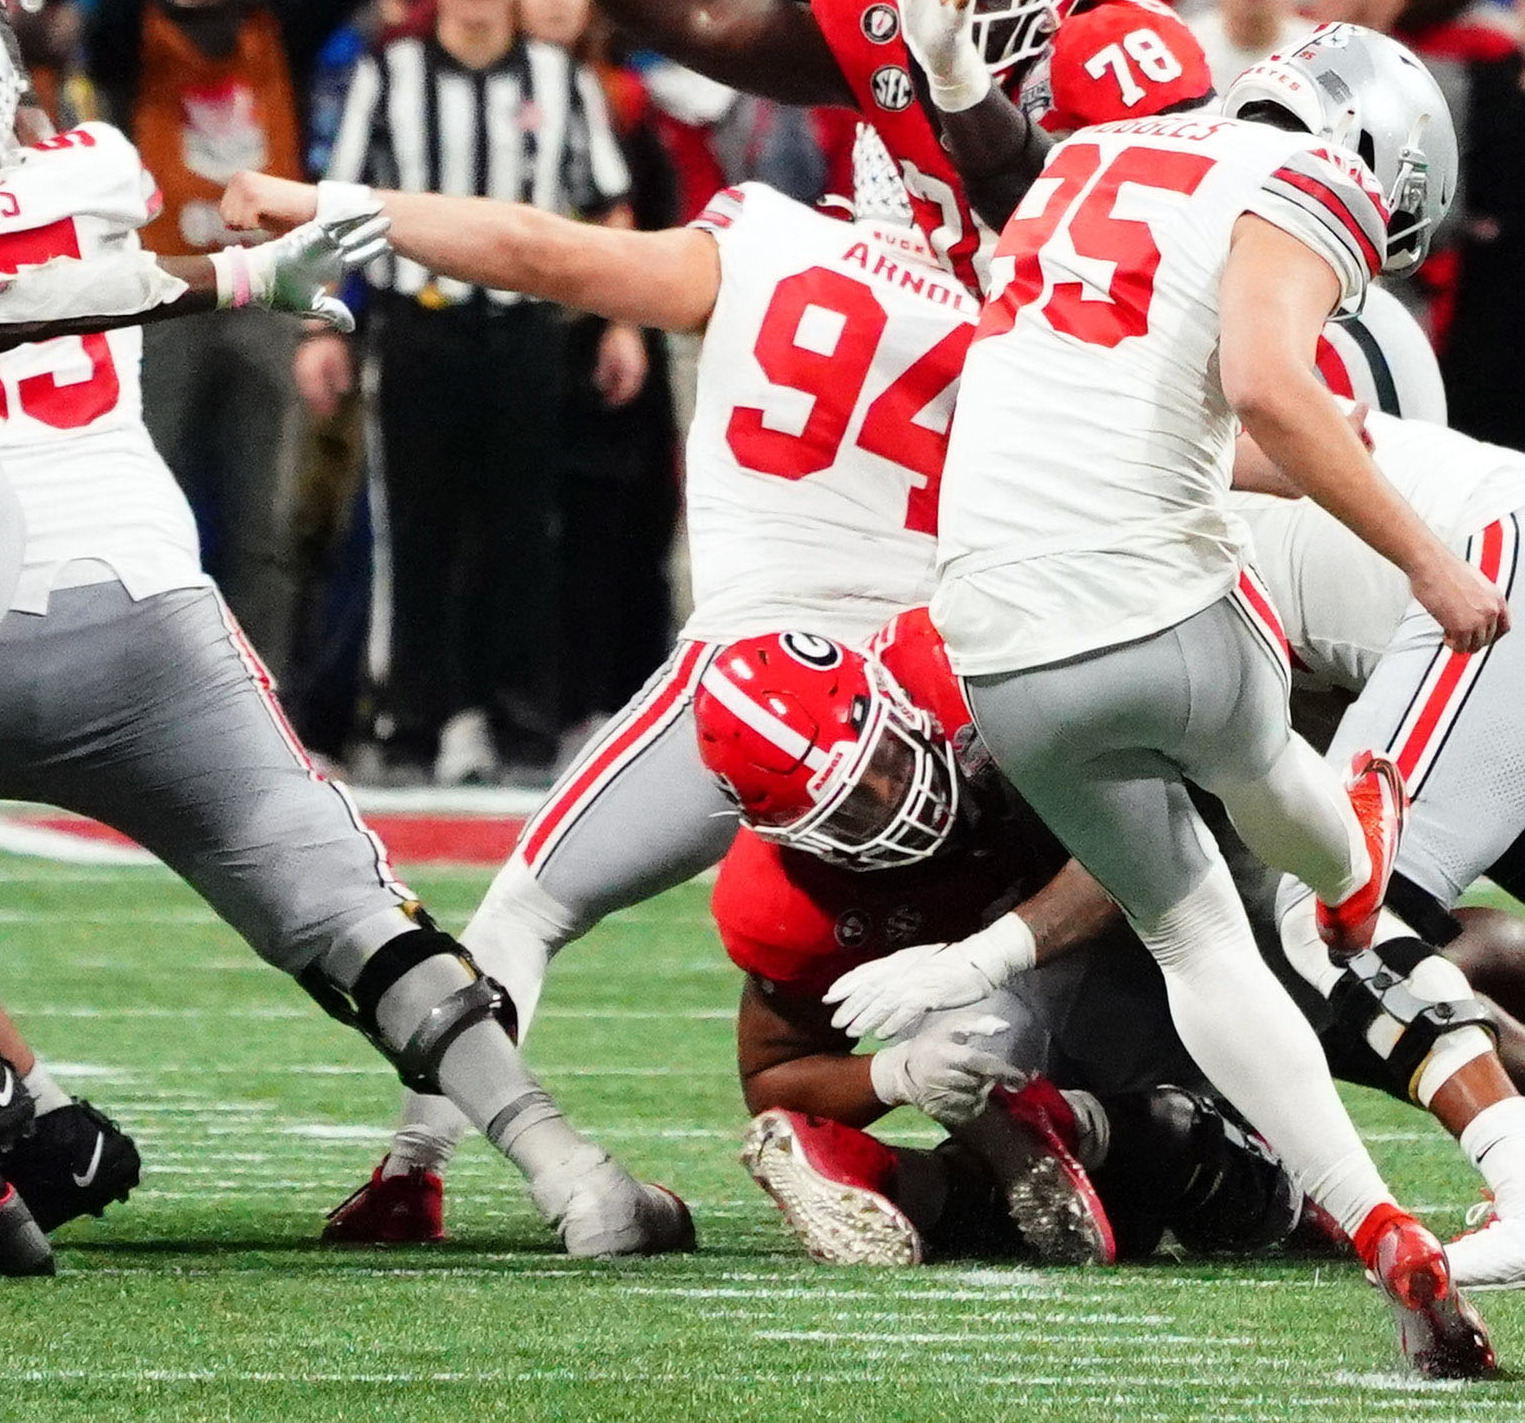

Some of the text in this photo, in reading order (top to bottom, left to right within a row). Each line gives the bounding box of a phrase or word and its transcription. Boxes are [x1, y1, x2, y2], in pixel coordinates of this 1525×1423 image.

[874, 67, 912, 109] SEC
[1083, 27, 1183, 107] 78
[975, 143, 1218, 349] 95
[725, 265, 978, 538] 94
